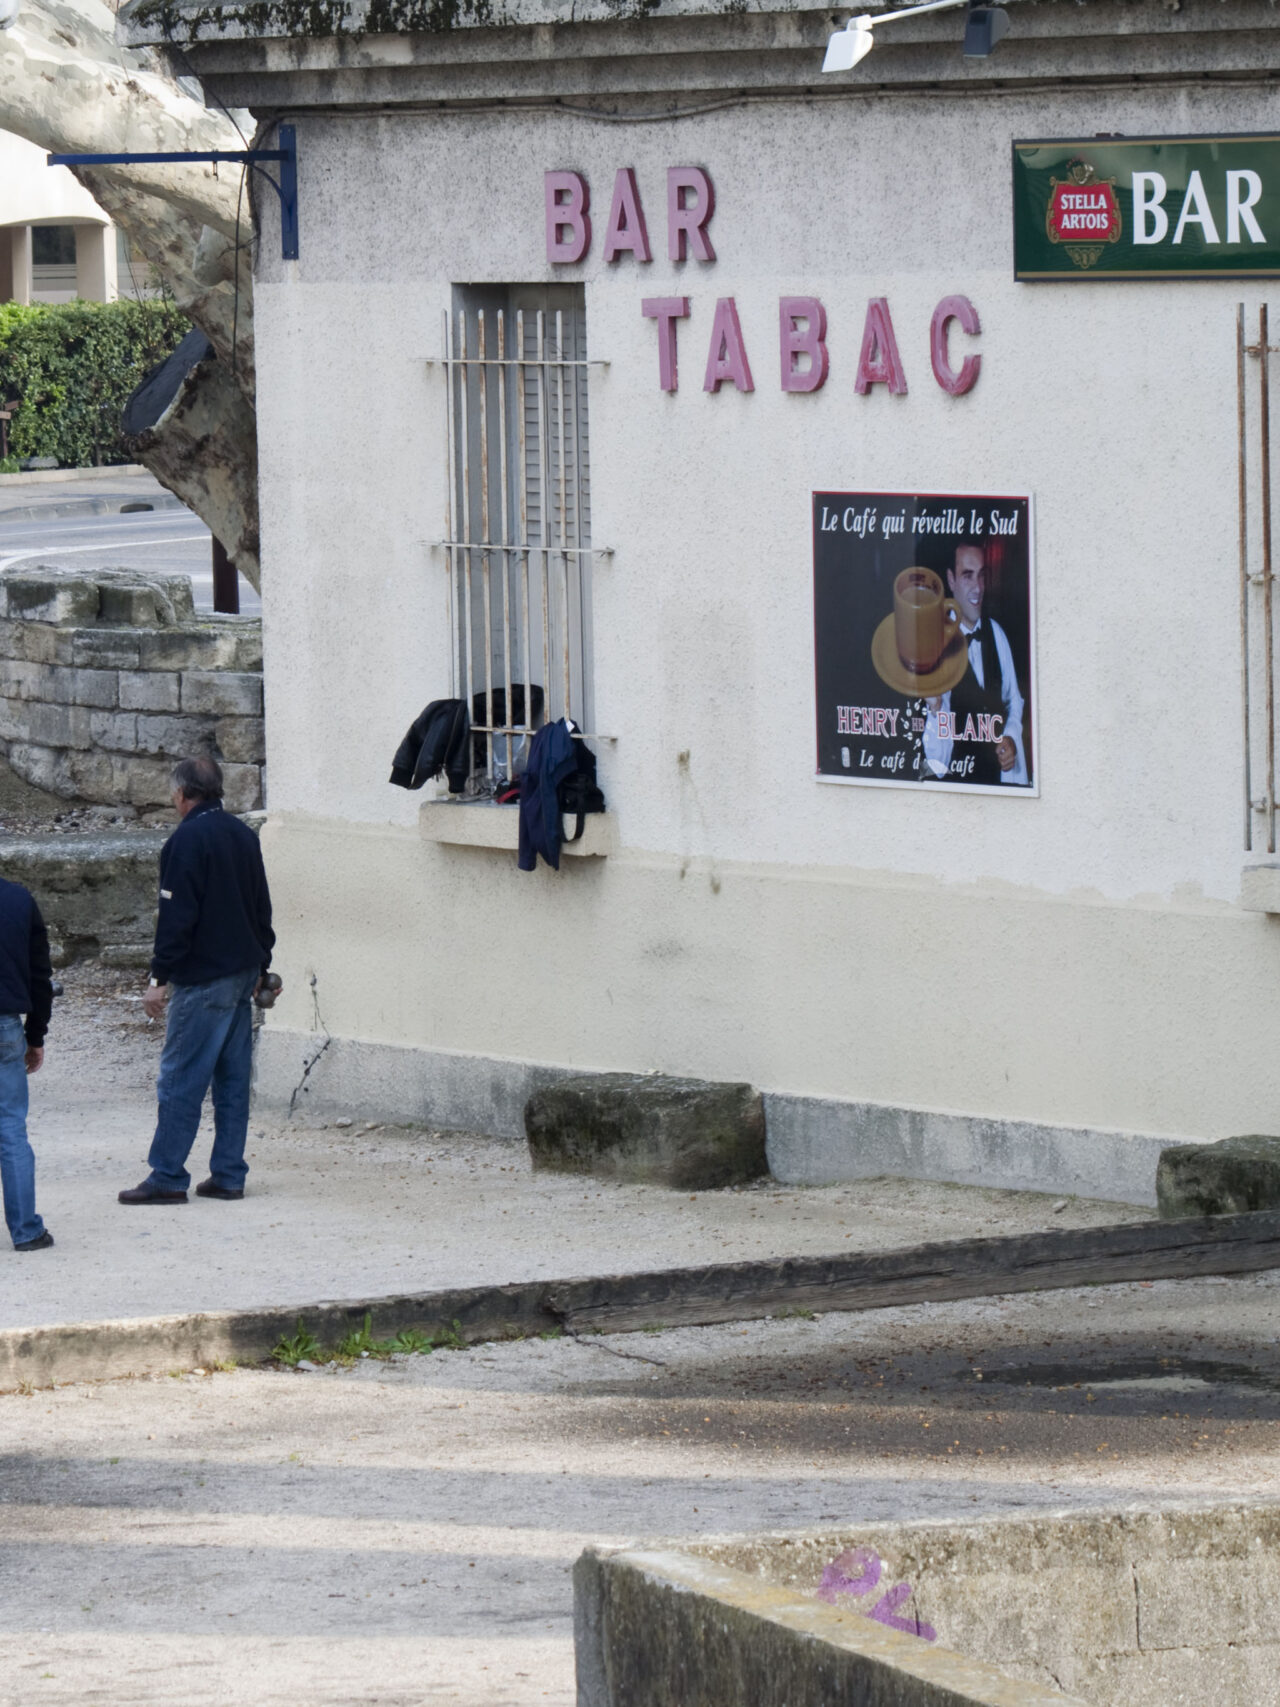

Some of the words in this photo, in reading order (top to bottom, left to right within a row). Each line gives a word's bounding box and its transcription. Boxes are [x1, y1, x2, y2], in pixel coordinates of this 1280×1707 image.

[544, 166, 716, 263] BAR
[1061, 193, 1108, 210] STELLA
[1132, 170, 1267, 245] BAR
[1061, 213, 1109, 230] ARTOIS
[641, 295, 982, 396] TABAC
[821, 506, 838, 532] Le
[843, 506, 877, 539] Café
[882, 508, 906, 540] qui
[911, 508, 966, 535] réveille
[969, 509, 984, 535] le
[989, 509, 1019, 536] Sud
[837, 706, 900, 738] HENRY
[936, 711, 1004, 744] BLANC
[859, 749, 875, 767] Le
[880, 751, 906, 774] café
[950, 755, 976, 778] café
